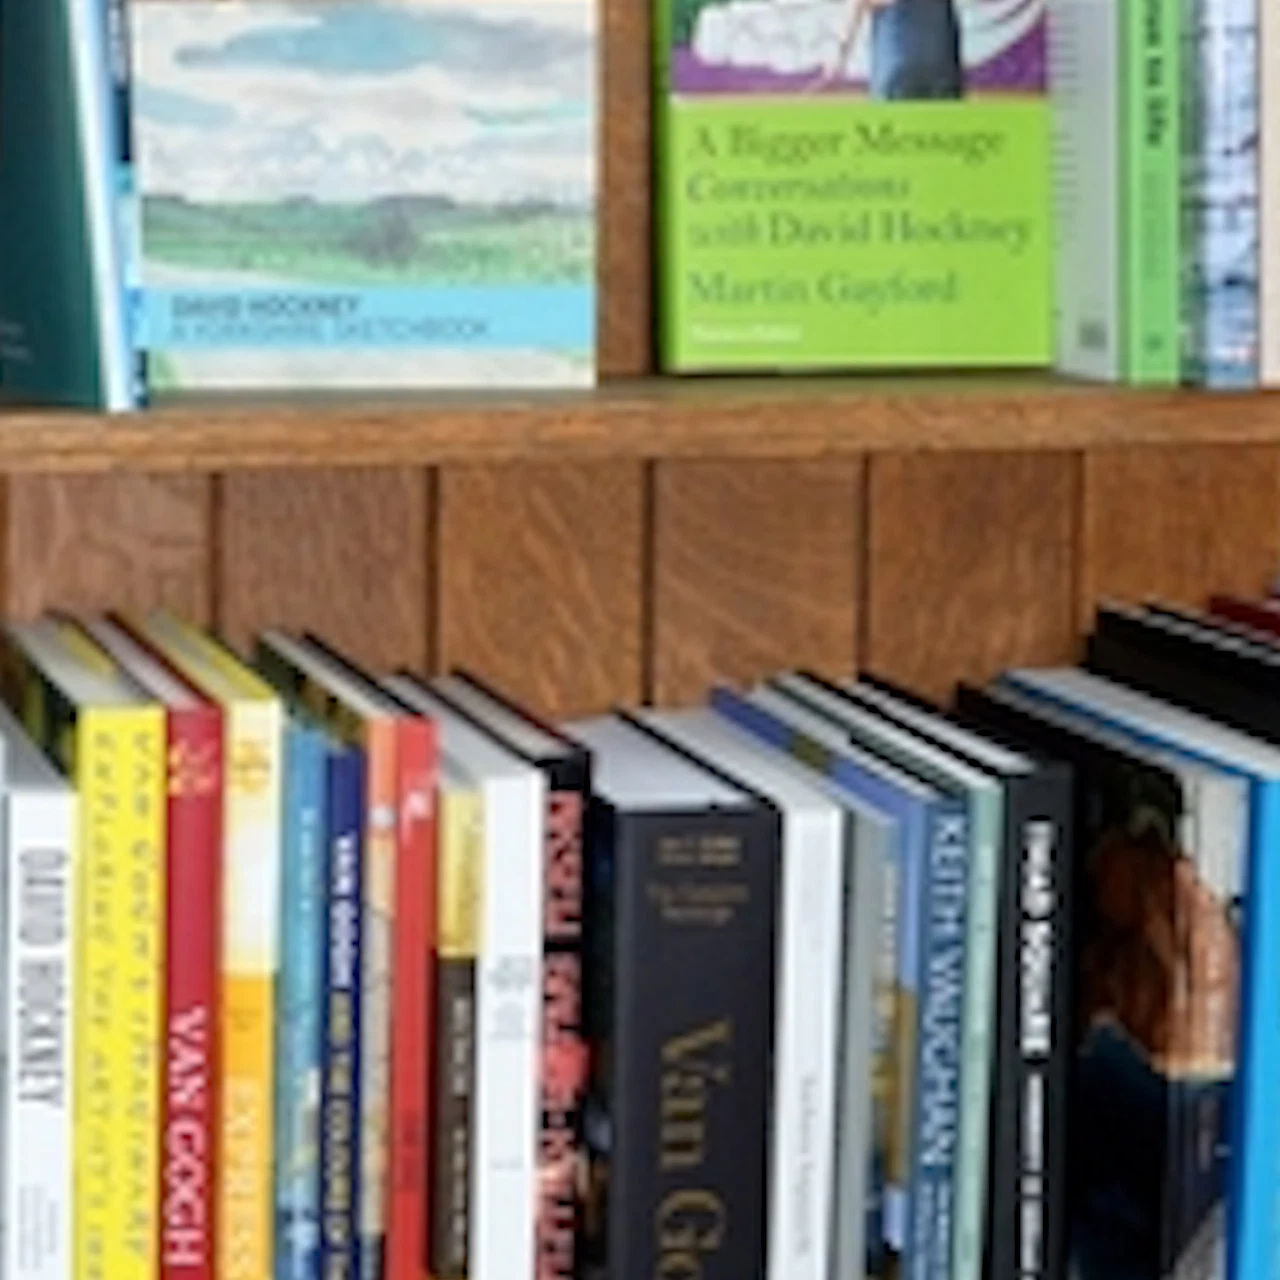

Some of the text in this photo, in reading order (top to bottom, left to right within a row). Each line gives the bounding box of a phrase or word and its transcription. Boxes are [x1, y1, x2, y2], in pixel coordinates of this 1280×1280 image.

[1143, 57, 1165, 89] to
[687, 122, 1006, 167] A Bigger Message
[1143, 96, 1167, 148] life
[686, 169, 913, 203] Conversations
[767, 211, 871, 245] David
[879, 209, 1031, 257] Hockney
[170, 295, 362, 318] DAVID HOCKNEY
[686, 269, 960, 317] Martin Gayford
[333, 833, 357, 894] VAN
[924, 816, 967, 934] KEITH
[331, 899, 355, 987] GOGH
[18, 848, 66, 1108] DAVID HOCKNEY
[1019, 921, 1052, 1054] SQUARE
[920, 947, 964, 1165] VAUGHAN
[661, 1017, 733, 1167] Van
[166, 1006, 207, 1268] VAN GOGH
